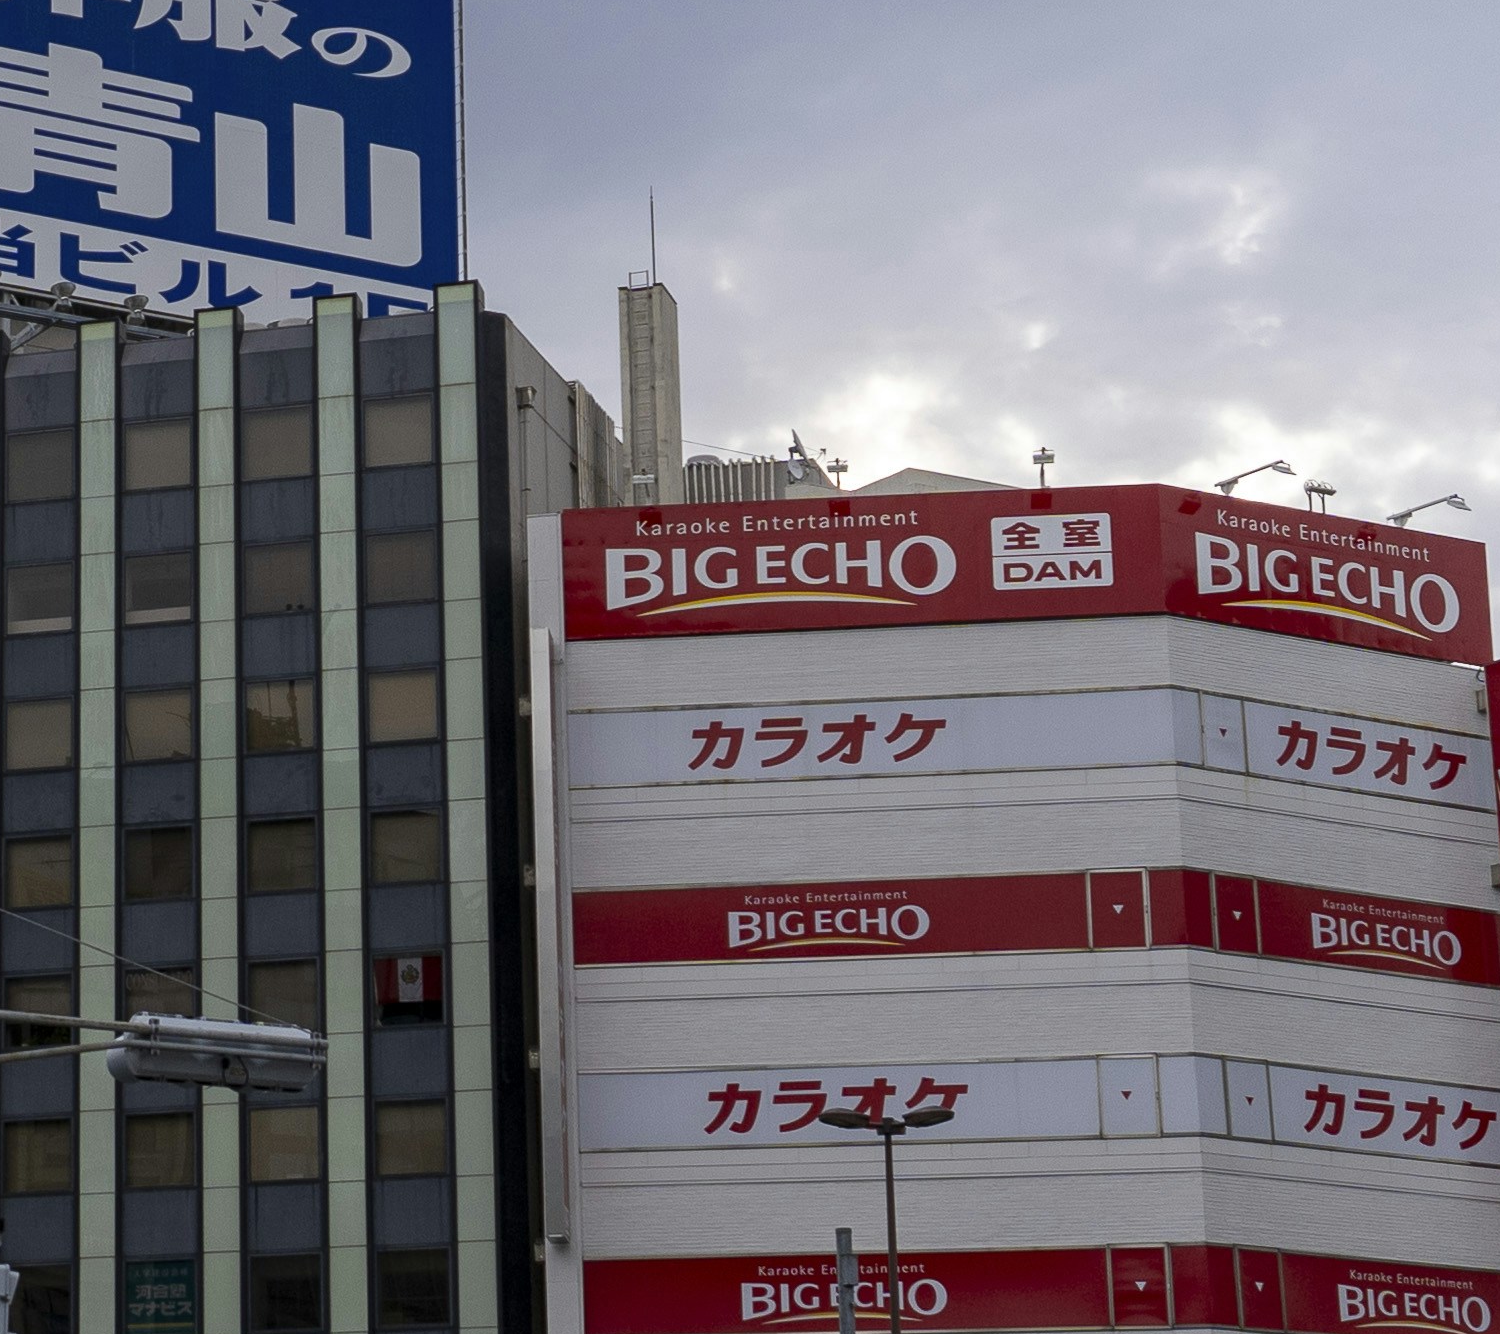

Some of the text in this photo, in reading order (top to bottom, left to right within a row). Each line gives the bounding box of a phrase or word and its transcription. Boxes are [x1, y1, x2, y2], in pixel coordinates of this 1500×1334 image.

[636, 510, 918, 537] Karaoke Entertainment
[1002, 519, 1102, 551] 全室
[1217, 509, 1430, 562] Karaoke Entertainment
[605, 535, 957, 610] BIG ECHO
[1003, 560, 1102, 583] DAM
[1195, 531, 1460, 634] BIG ECHO
[688, 713, 946, 770] カラオケ
[1276, 720, 1467, 790] カラオケ
[744, 889, 908, 905] Karaoke Entertainment
[1322, 898, 1445, 925] Karaoke Entertainment
[728, 904, 931, 949] BIG ECHO
[1312, 912, 1462, 966] BIG ECHO
[705, 1076, 969, 1136] カラオケ
[1305, 1083, 1498, 1151] カラオケ
[135, 1283, 187, 1300] 河合塾
[758, 1265, 817, 1278] Karaoke
[1349, 1269, 1474, 1292] Karaoke Entertainment
[128, 1301, 192, 1317] マナビス
[741, 1282, 821, 1321] BIG
[1339, 1283, 1492, 1334] BIG ECHO
